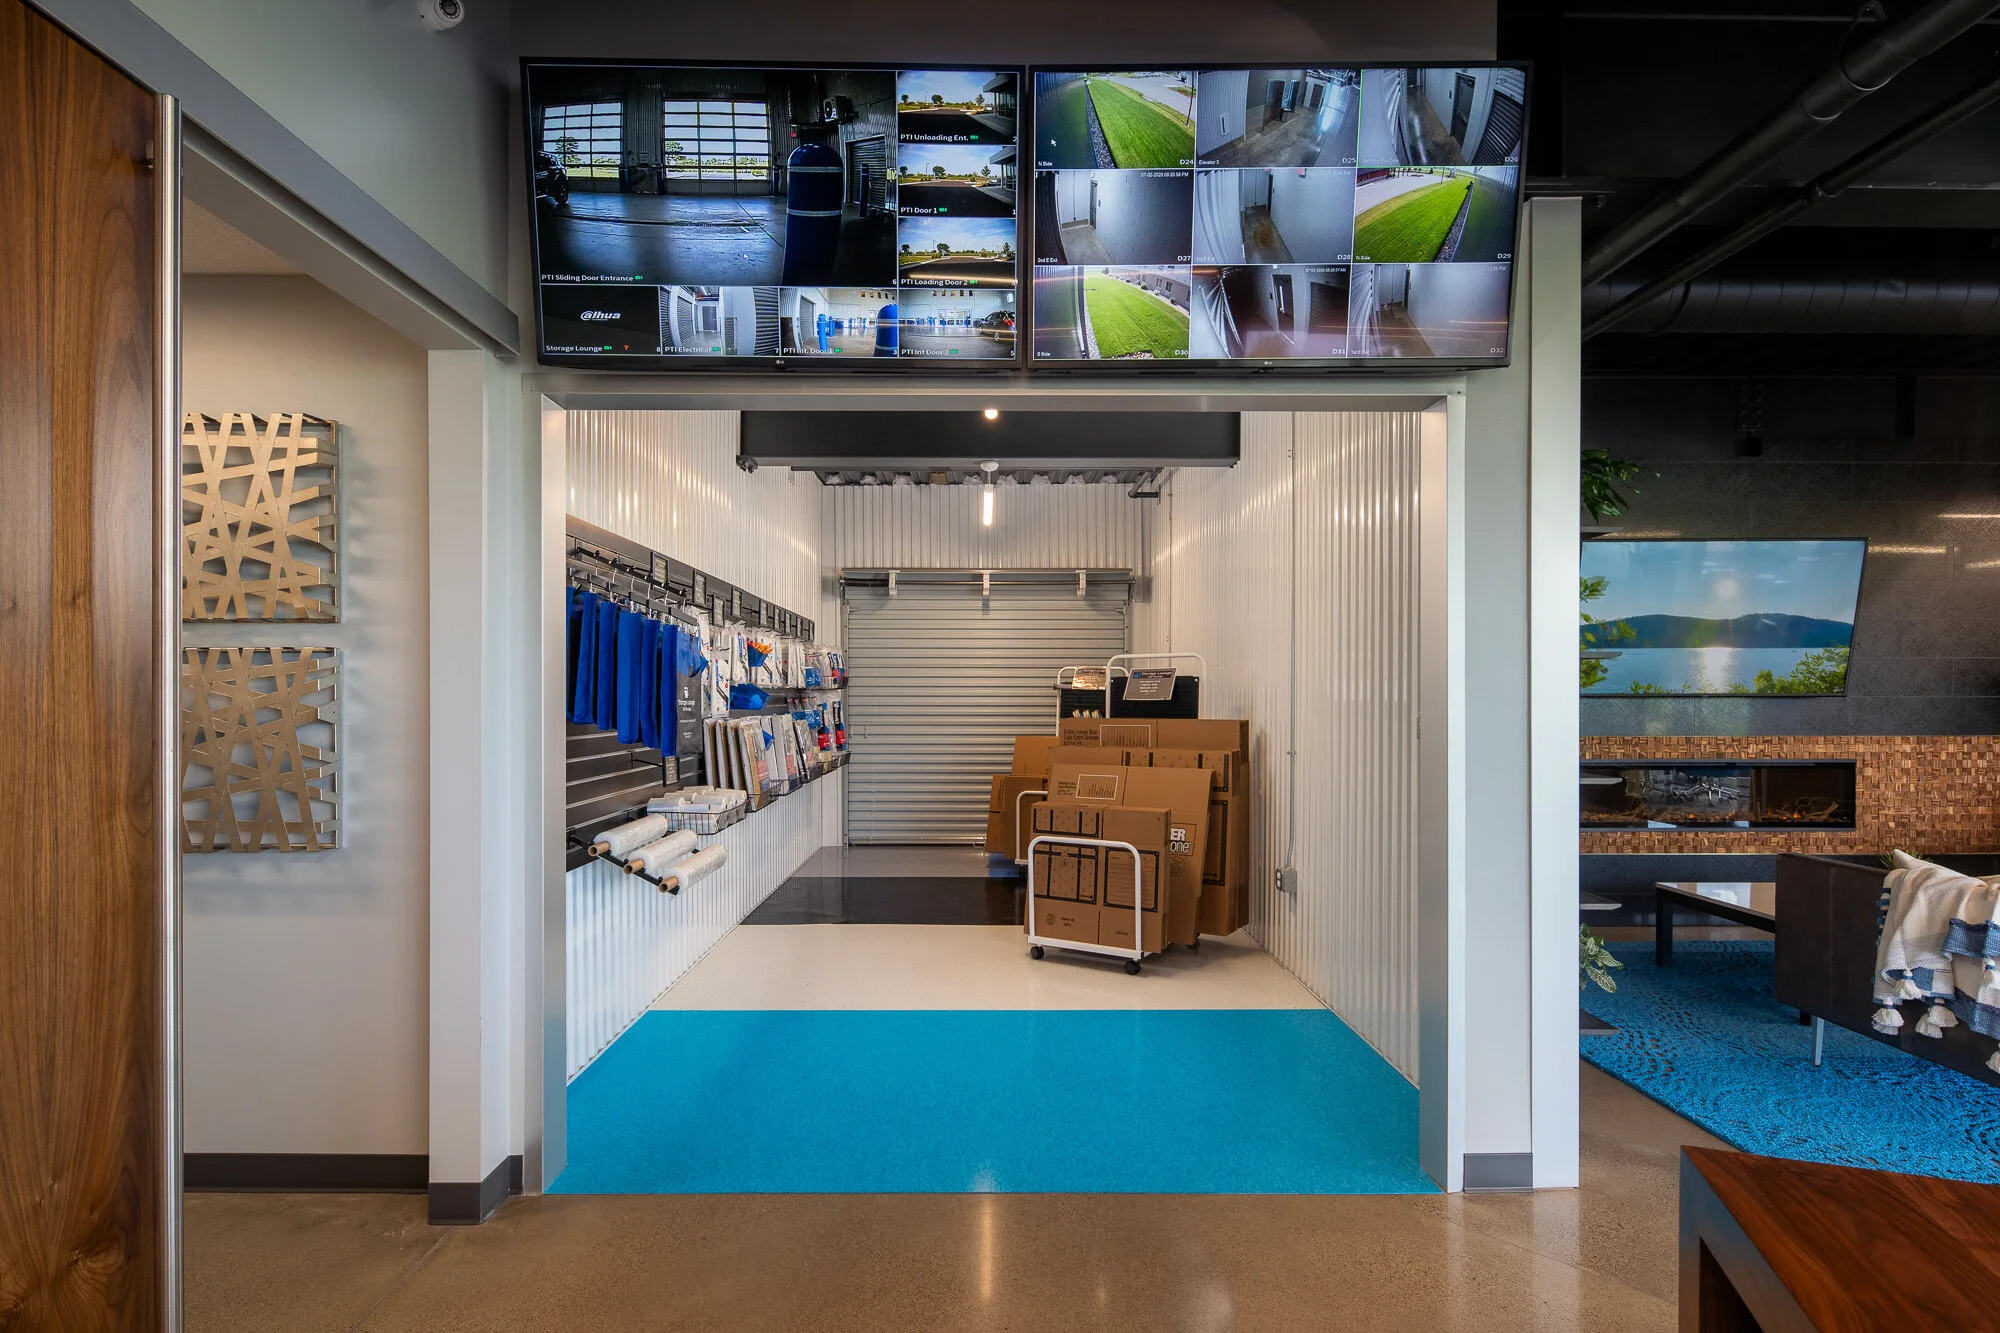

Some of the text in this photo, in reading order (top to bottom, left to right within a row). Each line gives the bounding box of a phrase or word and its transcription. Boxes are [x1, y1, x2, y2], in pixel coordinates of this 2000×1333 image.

[914, 134, 953, 142] Unloading
[555, 274, 581, 282] Sliding
[546, 345, 603, 353] Storage Lounge
[1075, 728, 1089, 736] Large
